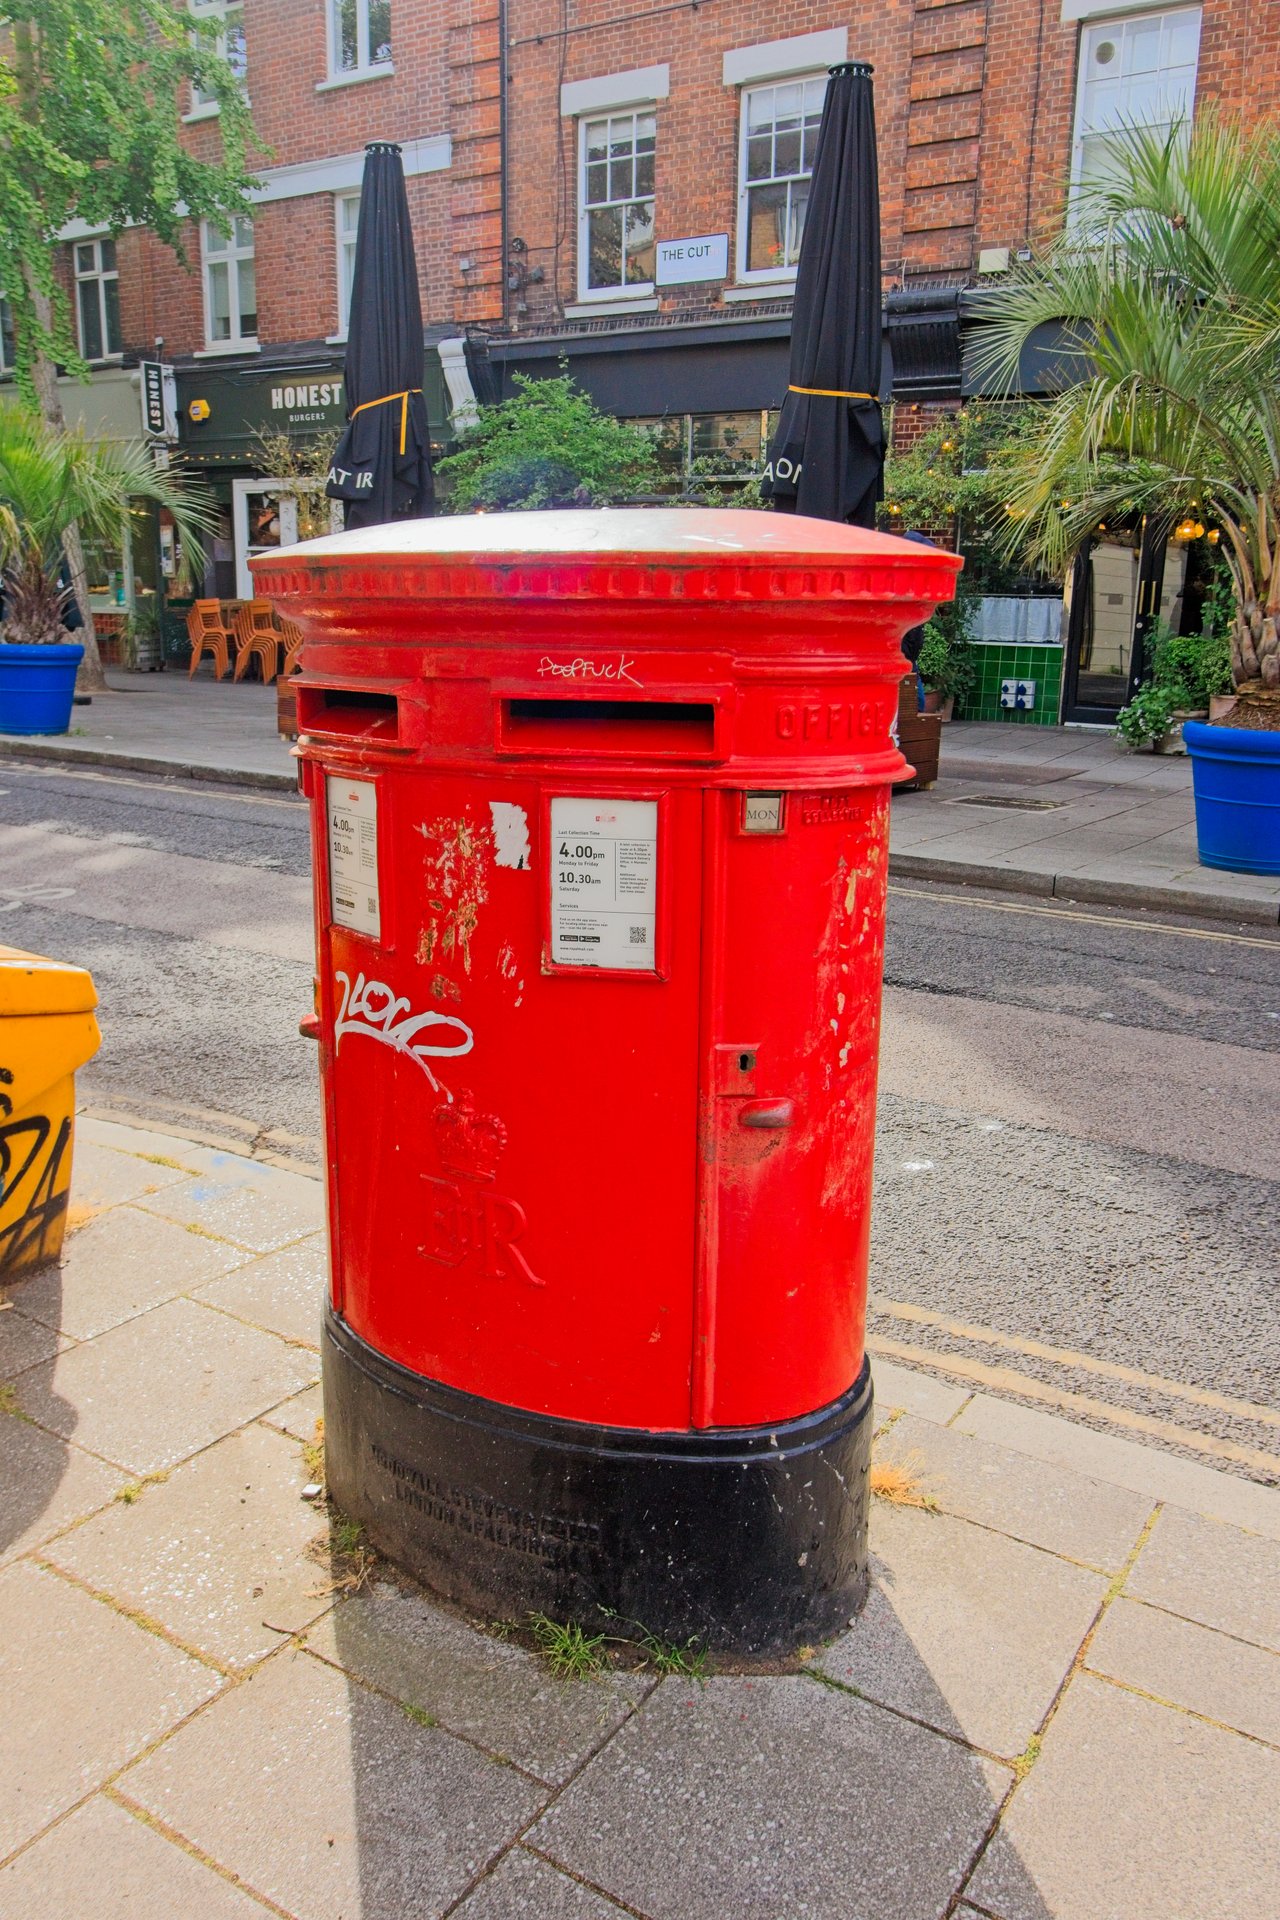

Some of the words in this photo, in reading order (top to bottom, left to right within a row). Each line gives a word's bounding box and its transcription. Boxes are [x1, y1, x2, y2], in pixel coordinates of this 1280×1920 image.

[662, 248, 684, 261] THE
[687, 245, 711, 258] CUT
[148, 369, 162, 428] HONEST
[271, 383, 343, 410] HONEST
[289, 412, 326, 423] BURGERS
[776, 702, 885, 740] OFFICE
[747, 810, 778, 821] MON
[559, 841, 605, 860] 4.00pm
[559, 871, 601, 885] 10.30am
